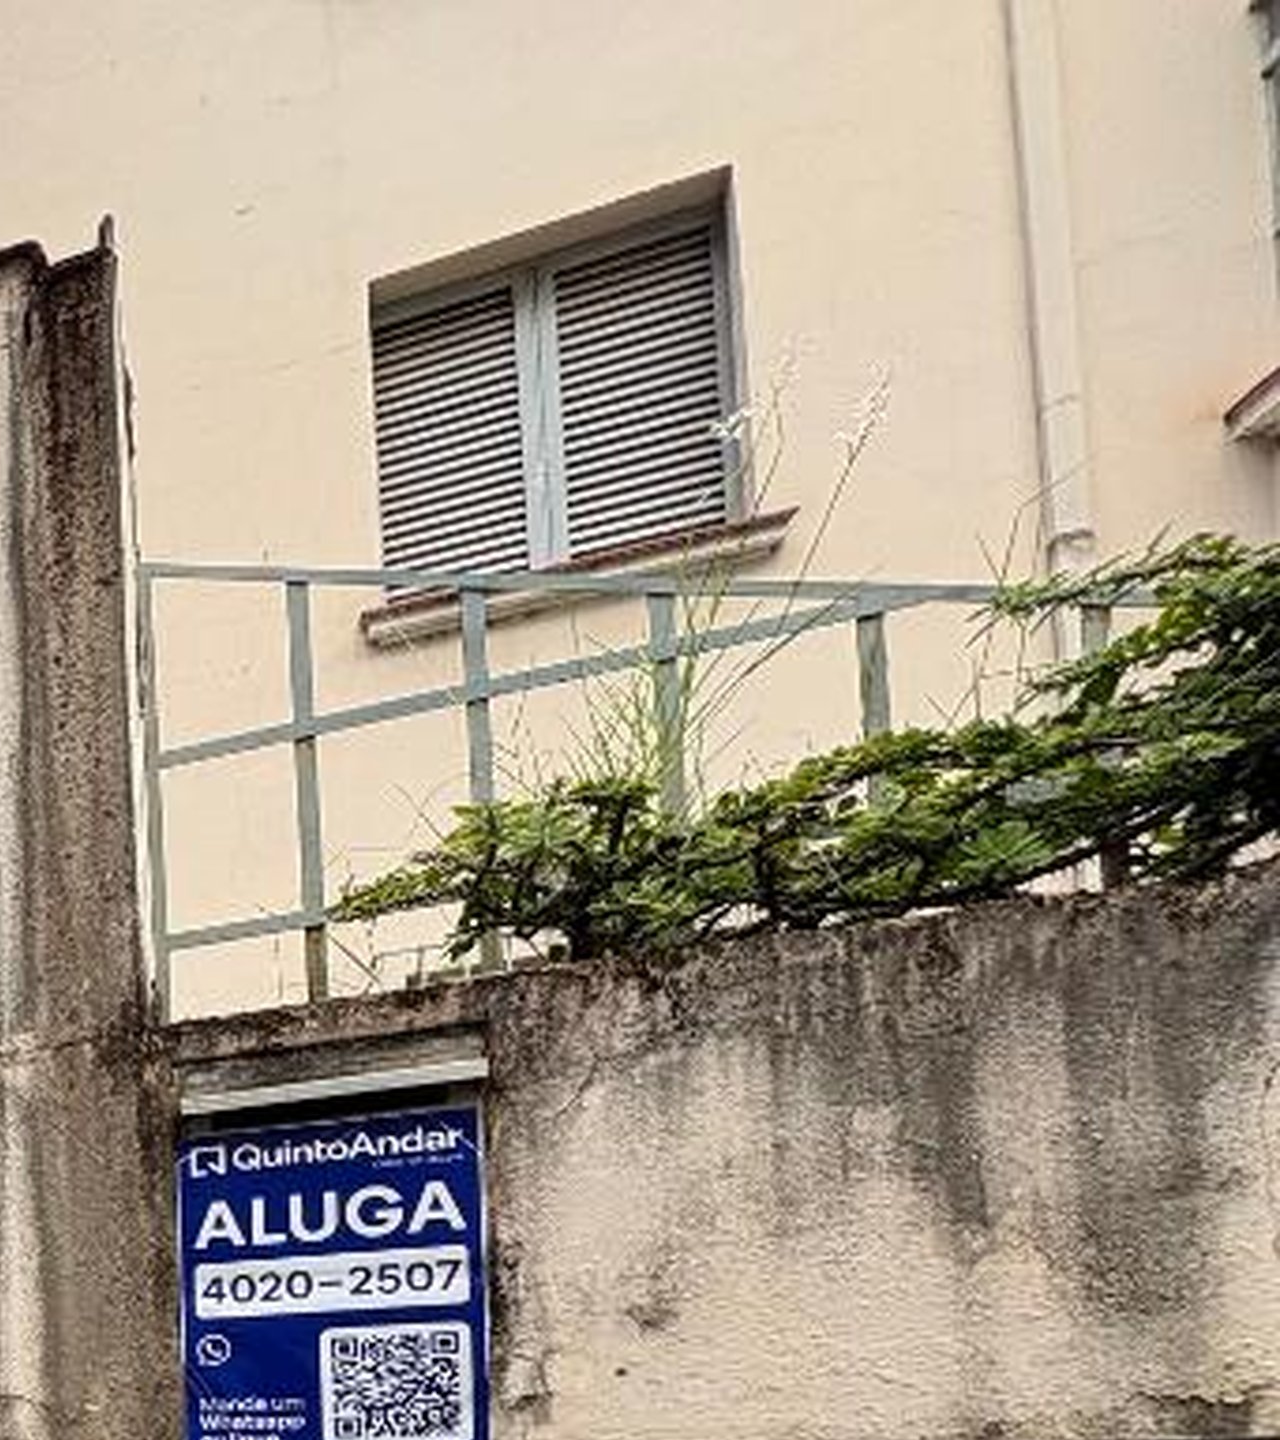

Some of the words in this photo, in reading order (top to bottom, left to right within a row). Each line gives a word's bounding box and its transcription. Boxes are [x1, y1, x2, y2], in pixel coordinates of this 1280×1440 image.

[232, 1126, 463, 1170] QuintoAndar
[193, 1180, 467, 1250] ALUGA
[201, 1257, 462, 1306] 4020-2507
